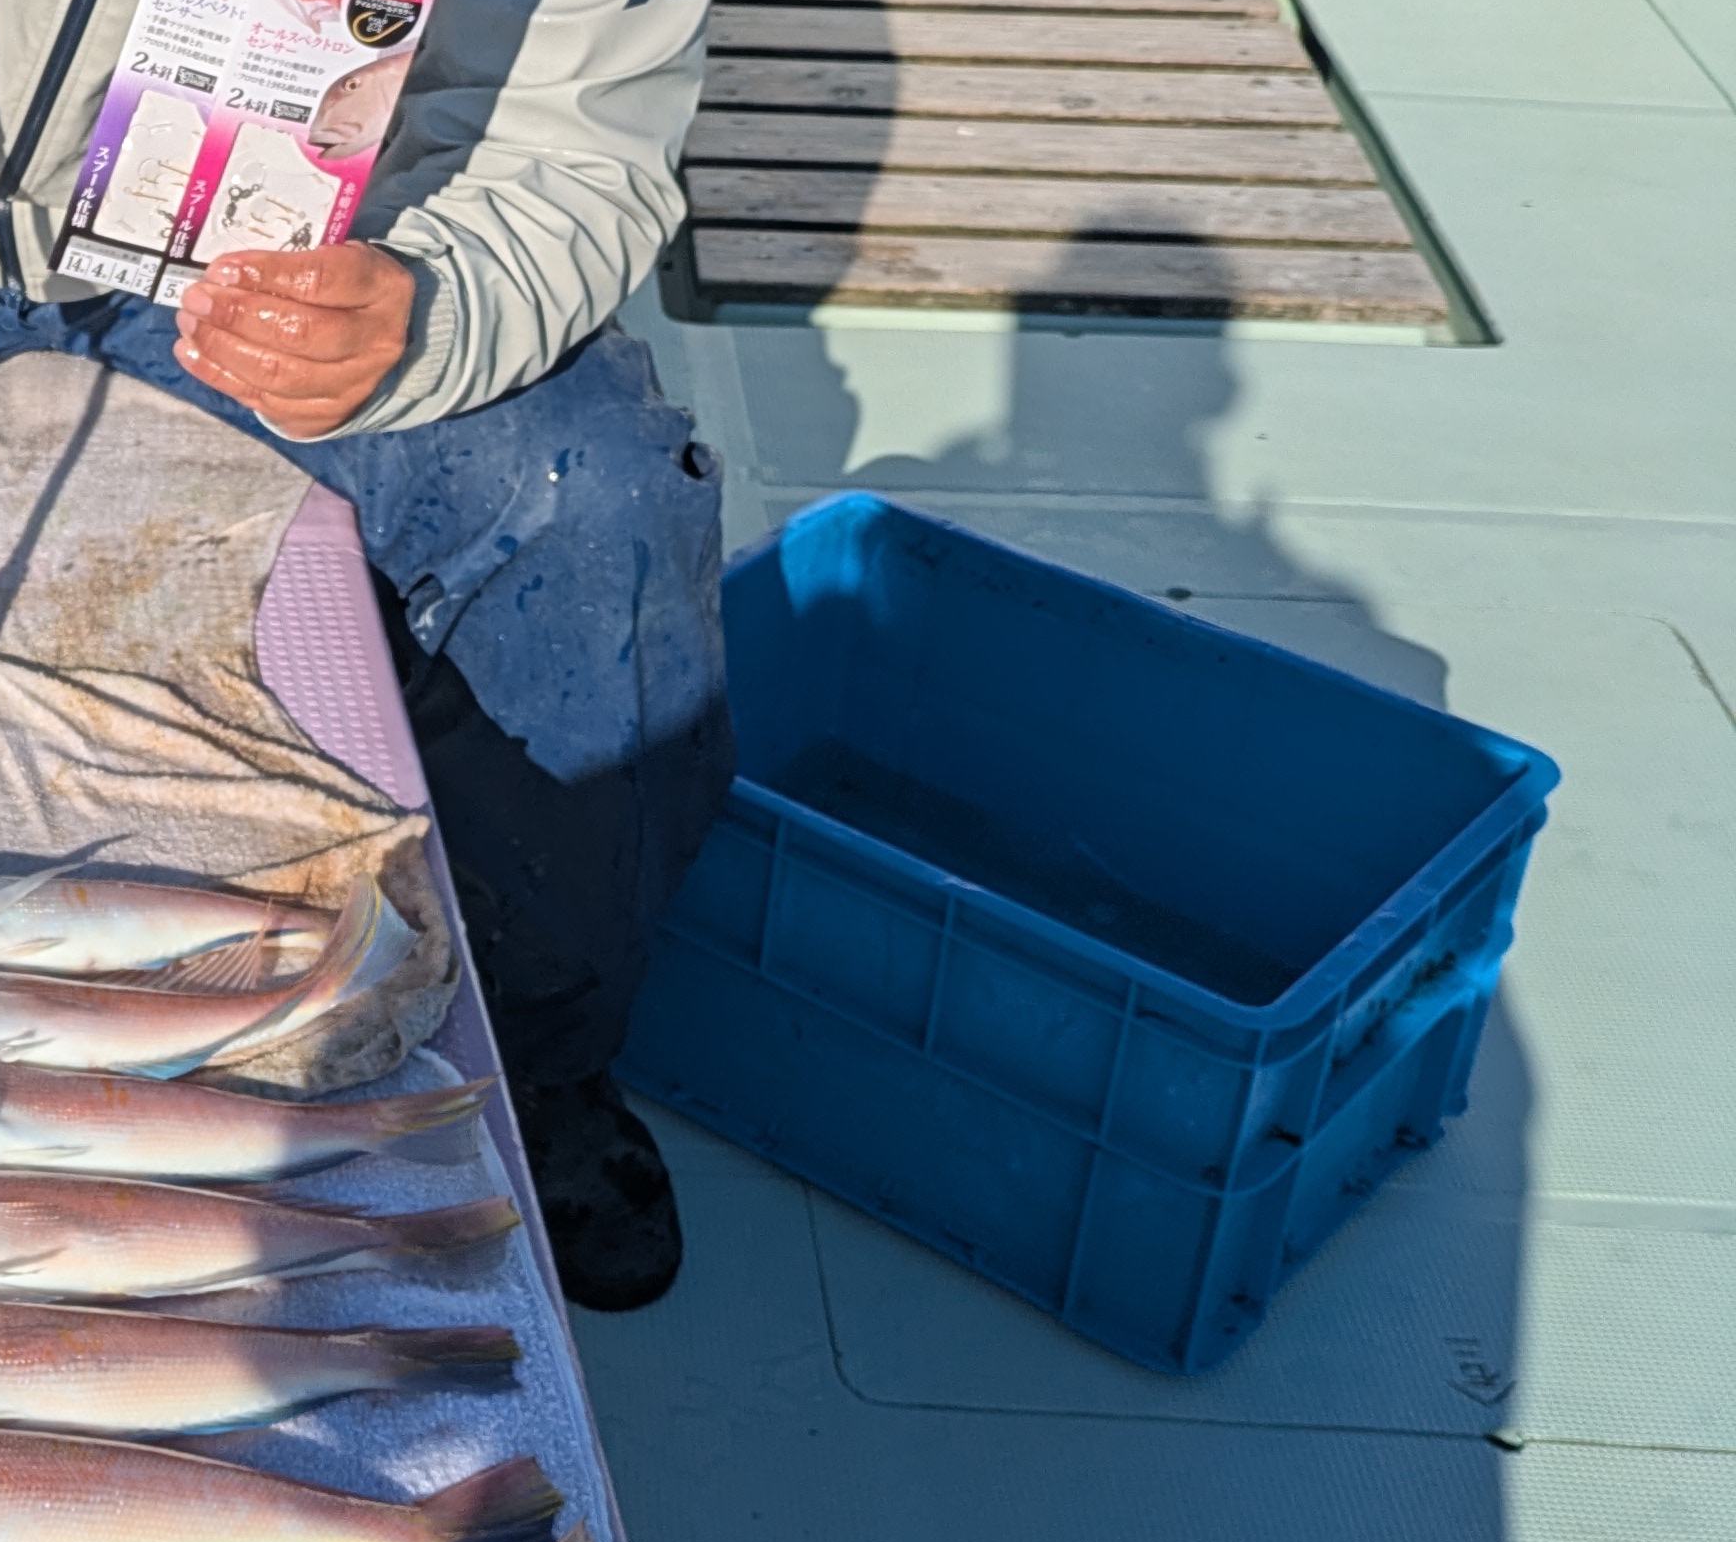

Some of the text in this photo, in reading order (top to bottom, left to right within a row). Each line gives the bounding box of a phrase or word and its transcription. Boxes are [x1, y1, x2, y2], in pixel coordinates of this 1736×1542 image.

[246, 35, 297, 54] センサー
[250, 22, 355, 54] オールスペクトロン
[130, 51, 173, 81] 2本針
[225, 87, 268, 116] 2本針
[71, 146, 110, 229] スプール仕様
[169, 179, 207, 259] スプール仕様
